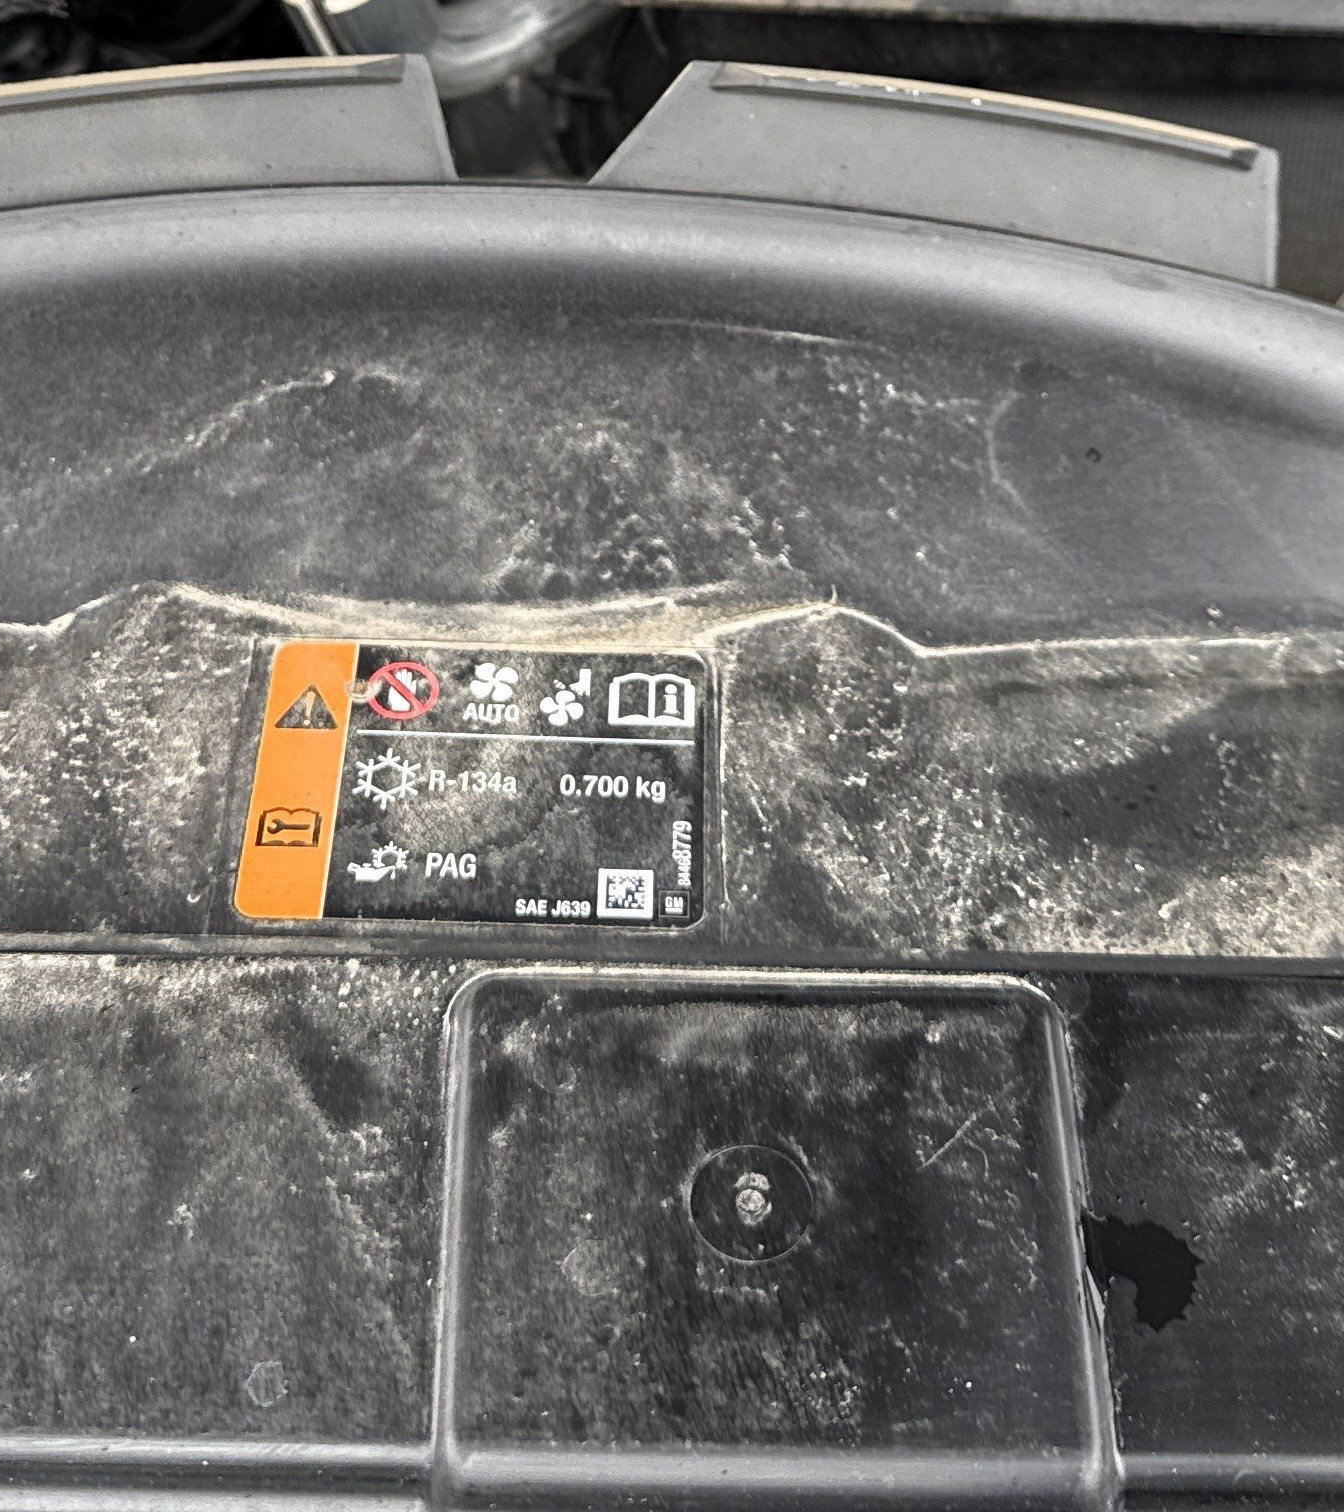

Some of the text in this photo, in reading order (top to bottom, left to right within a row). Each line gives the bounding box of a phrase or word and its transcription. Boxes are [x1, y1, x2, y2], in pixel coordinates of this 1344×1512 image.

[462, 702, 521, 725] AUTO
[428, 769, 518, 795] R-134a
[559, 773, 667, 804] 0.700 kg
[424, 852, 477, 879] PAG
[515, 899, 592, 918] SAE J639
